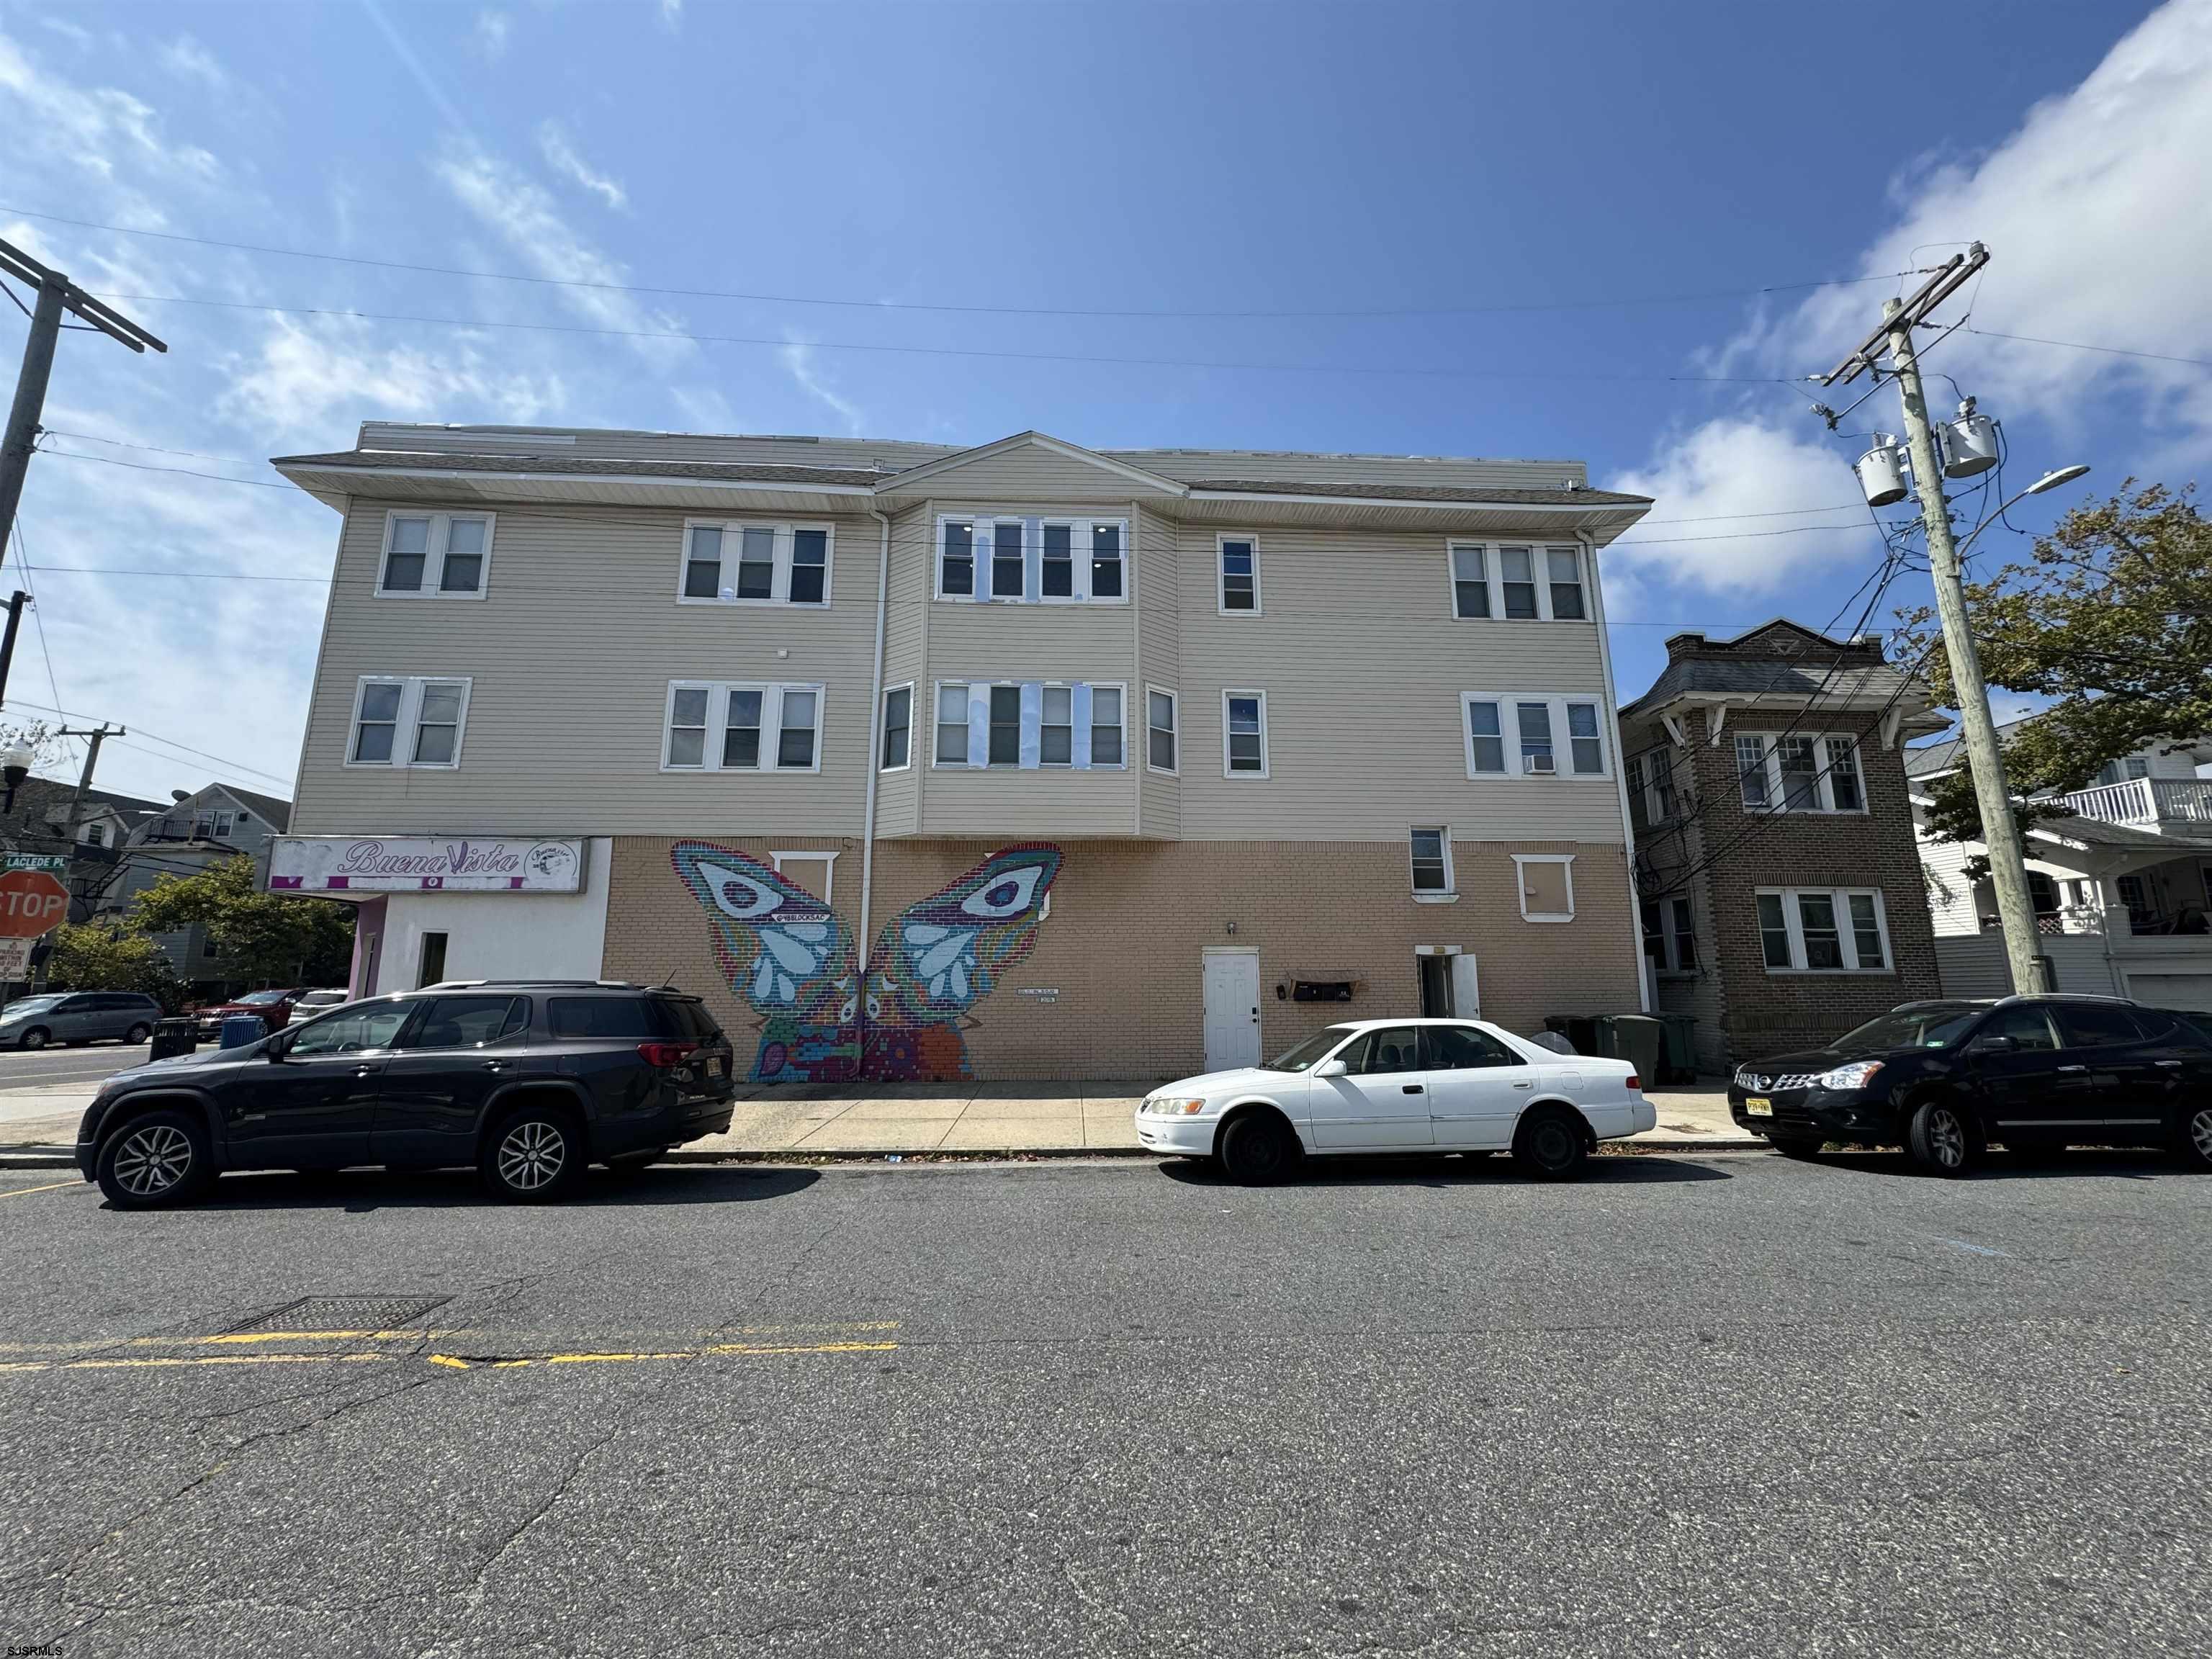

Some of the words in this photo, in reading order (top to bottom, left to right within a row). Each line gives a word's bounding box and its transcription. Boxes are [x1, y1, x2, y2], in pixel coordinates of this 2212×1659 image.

[6, 858, 50, 867] LACLEDE
[53, 858, 65, 867] PL
[337, 840, 447, 873] Buena
[446, 841, 519, 874] Vista
